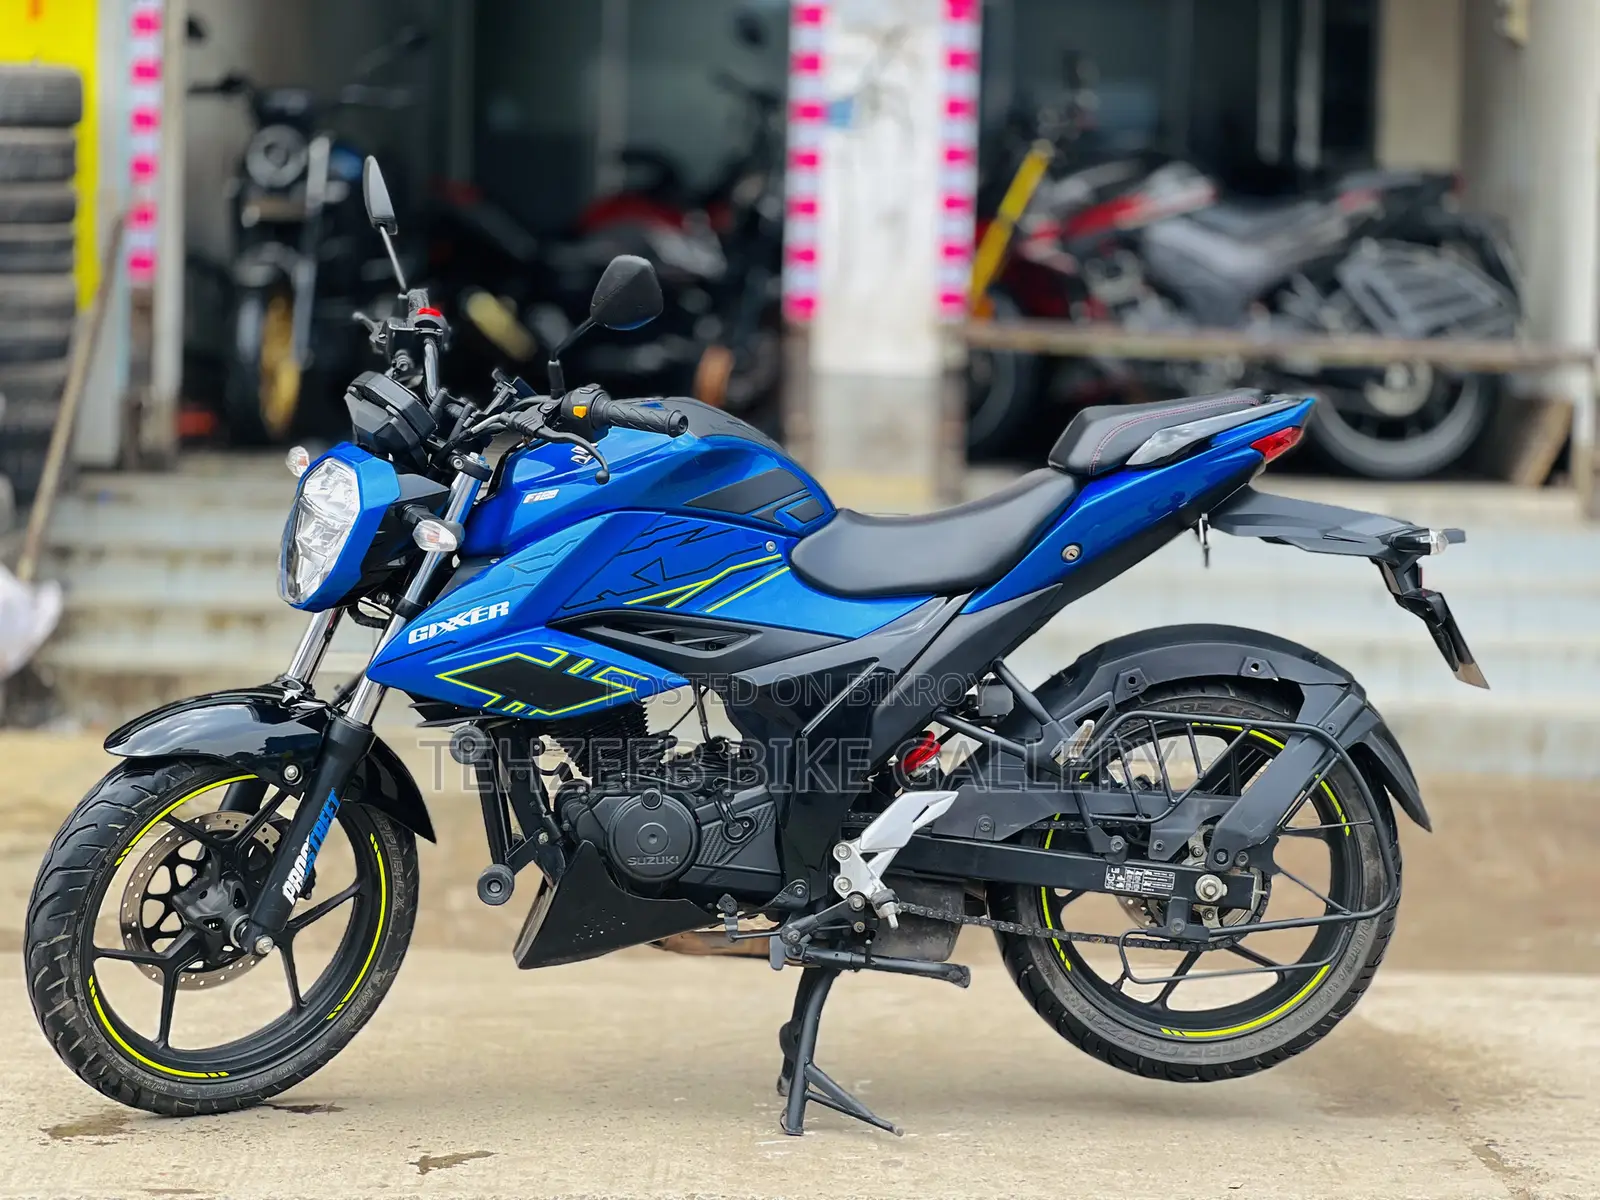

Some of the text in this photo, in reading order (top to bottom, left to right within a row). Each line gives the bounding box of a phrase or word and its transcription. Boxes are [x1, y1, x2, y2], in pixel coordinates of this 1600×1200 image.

[408, 601, 510, 645] GIXXER
[283, 787, 340, 906] PROSTREET
[627, 855, 680, 866] SUZUKI
